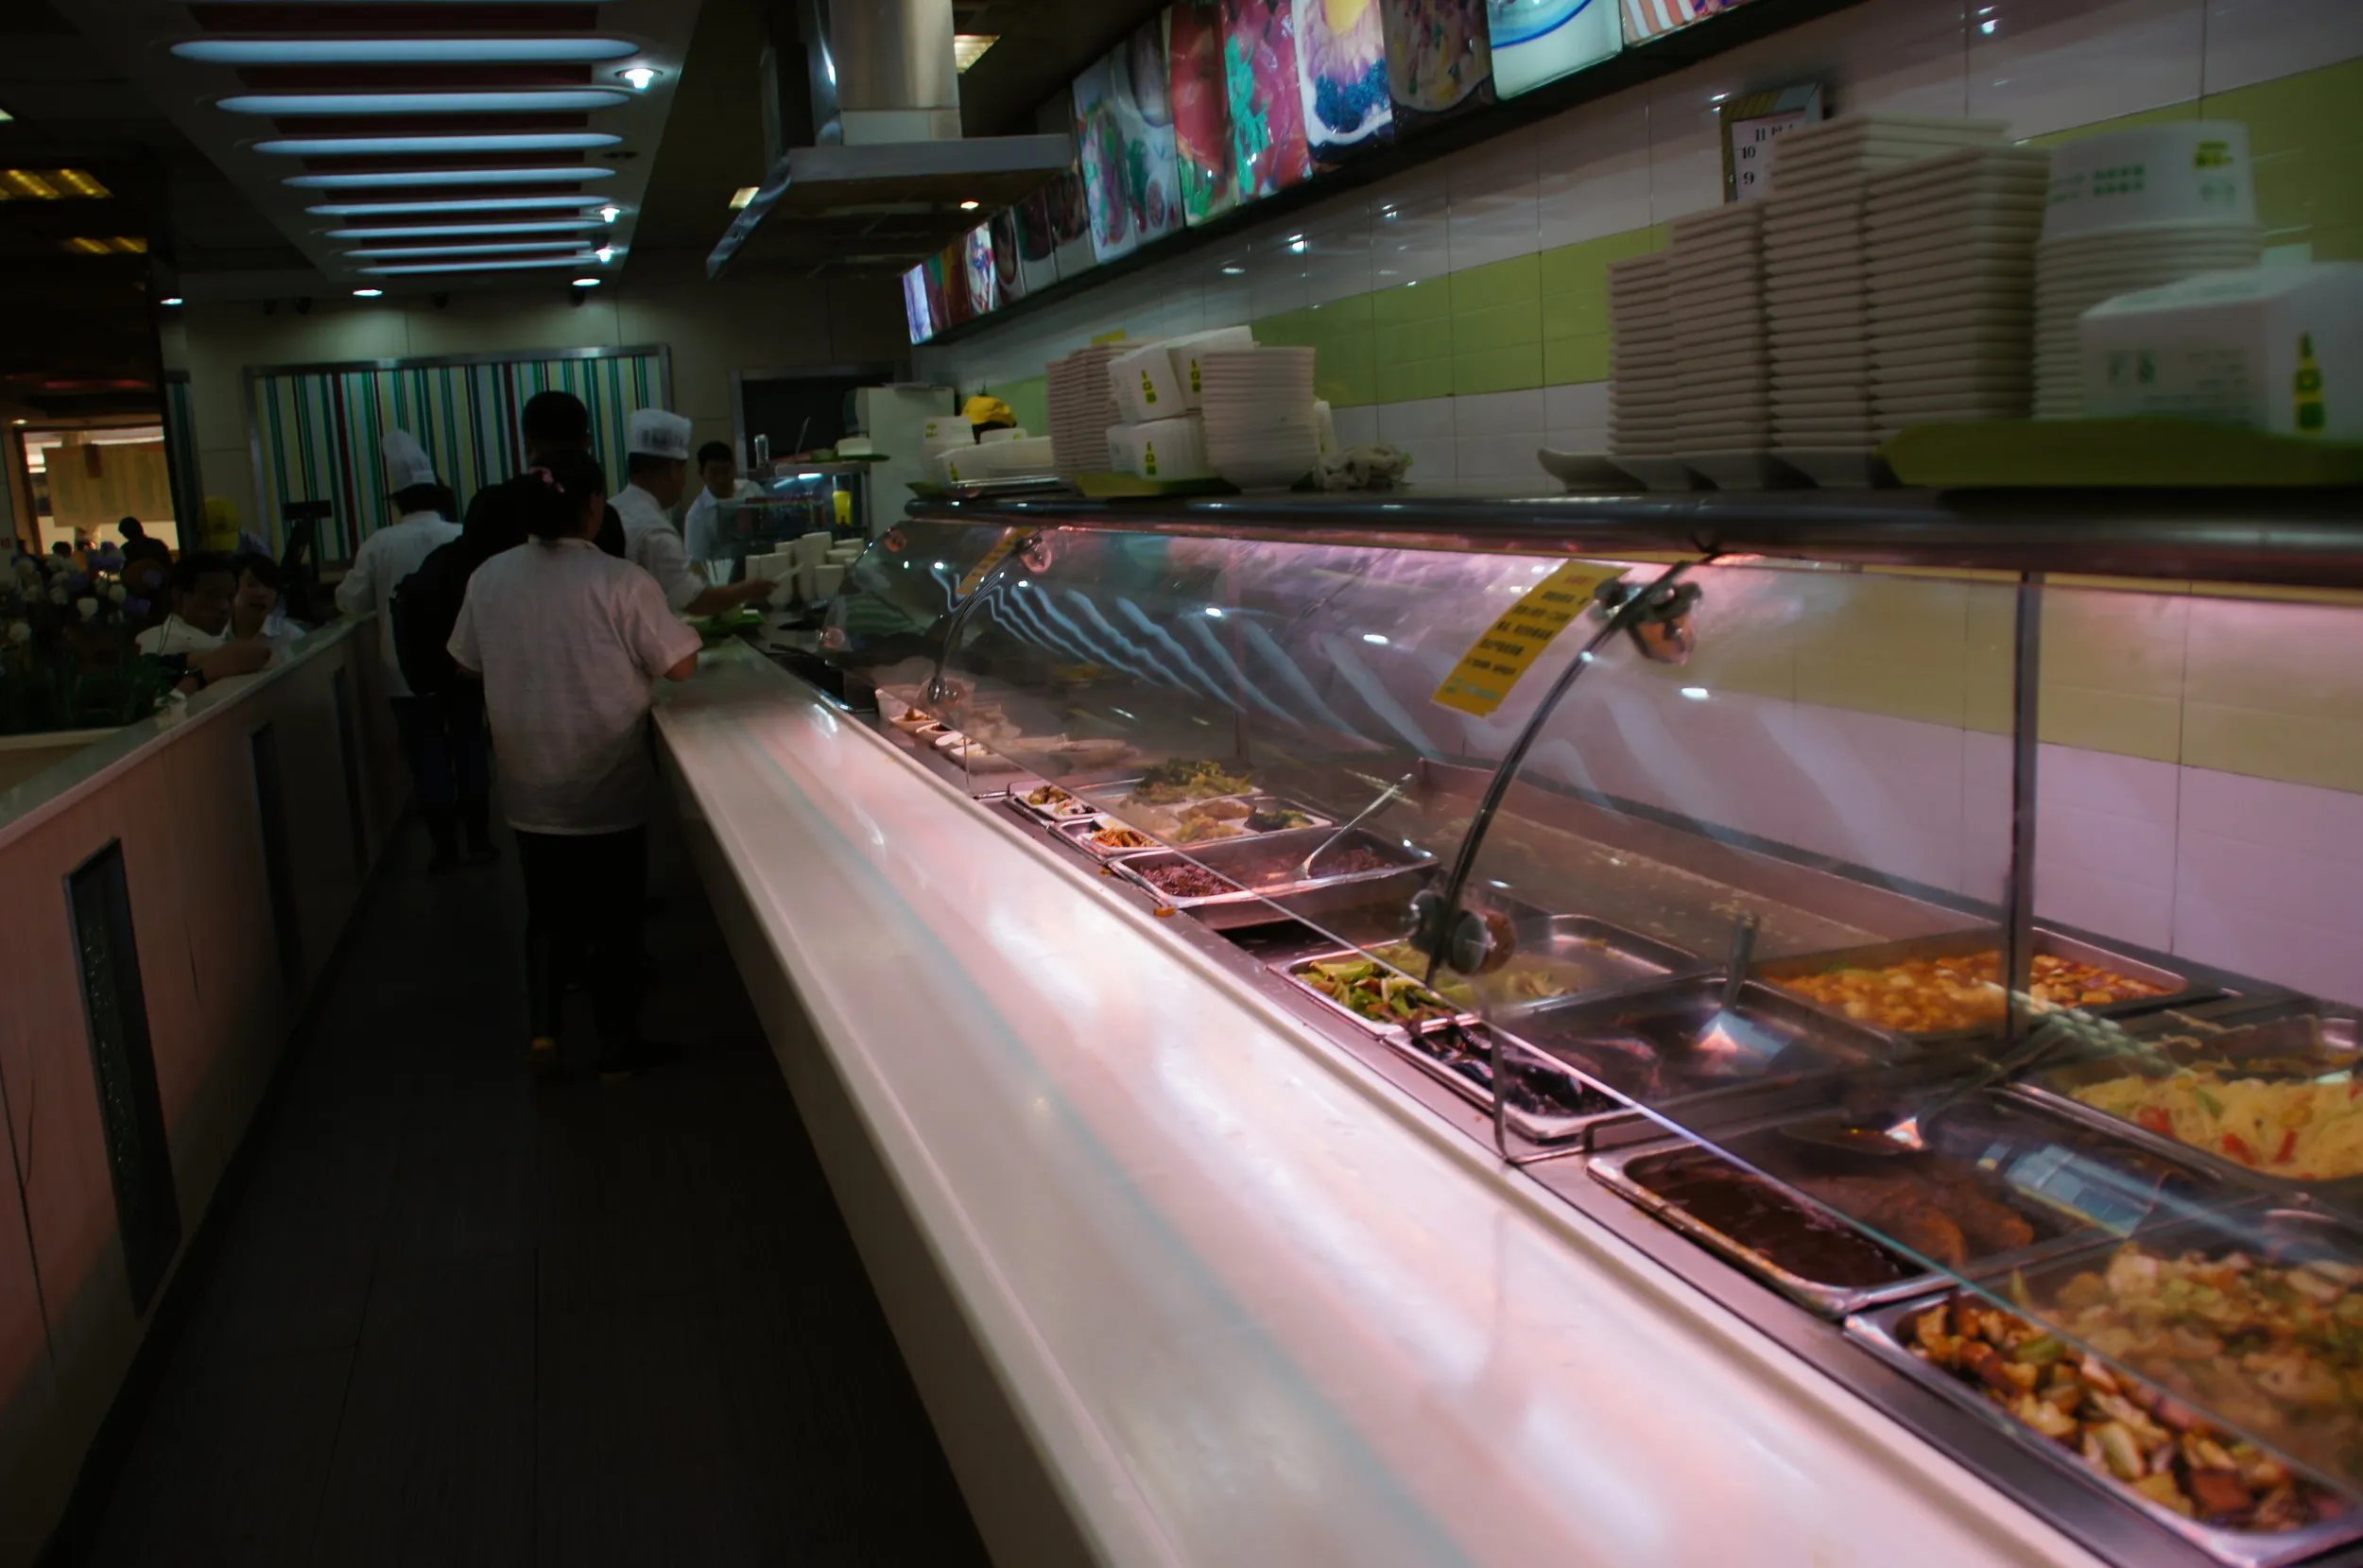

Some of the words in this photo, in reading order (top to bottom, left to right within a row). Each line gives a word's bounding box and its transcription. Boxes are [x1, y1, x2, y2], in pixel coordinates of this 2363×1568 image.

[1755, 129, 1766, 141] 11
[1743, 146, 1755, 159] 10
[1744, 172, 1754, 184] 9
